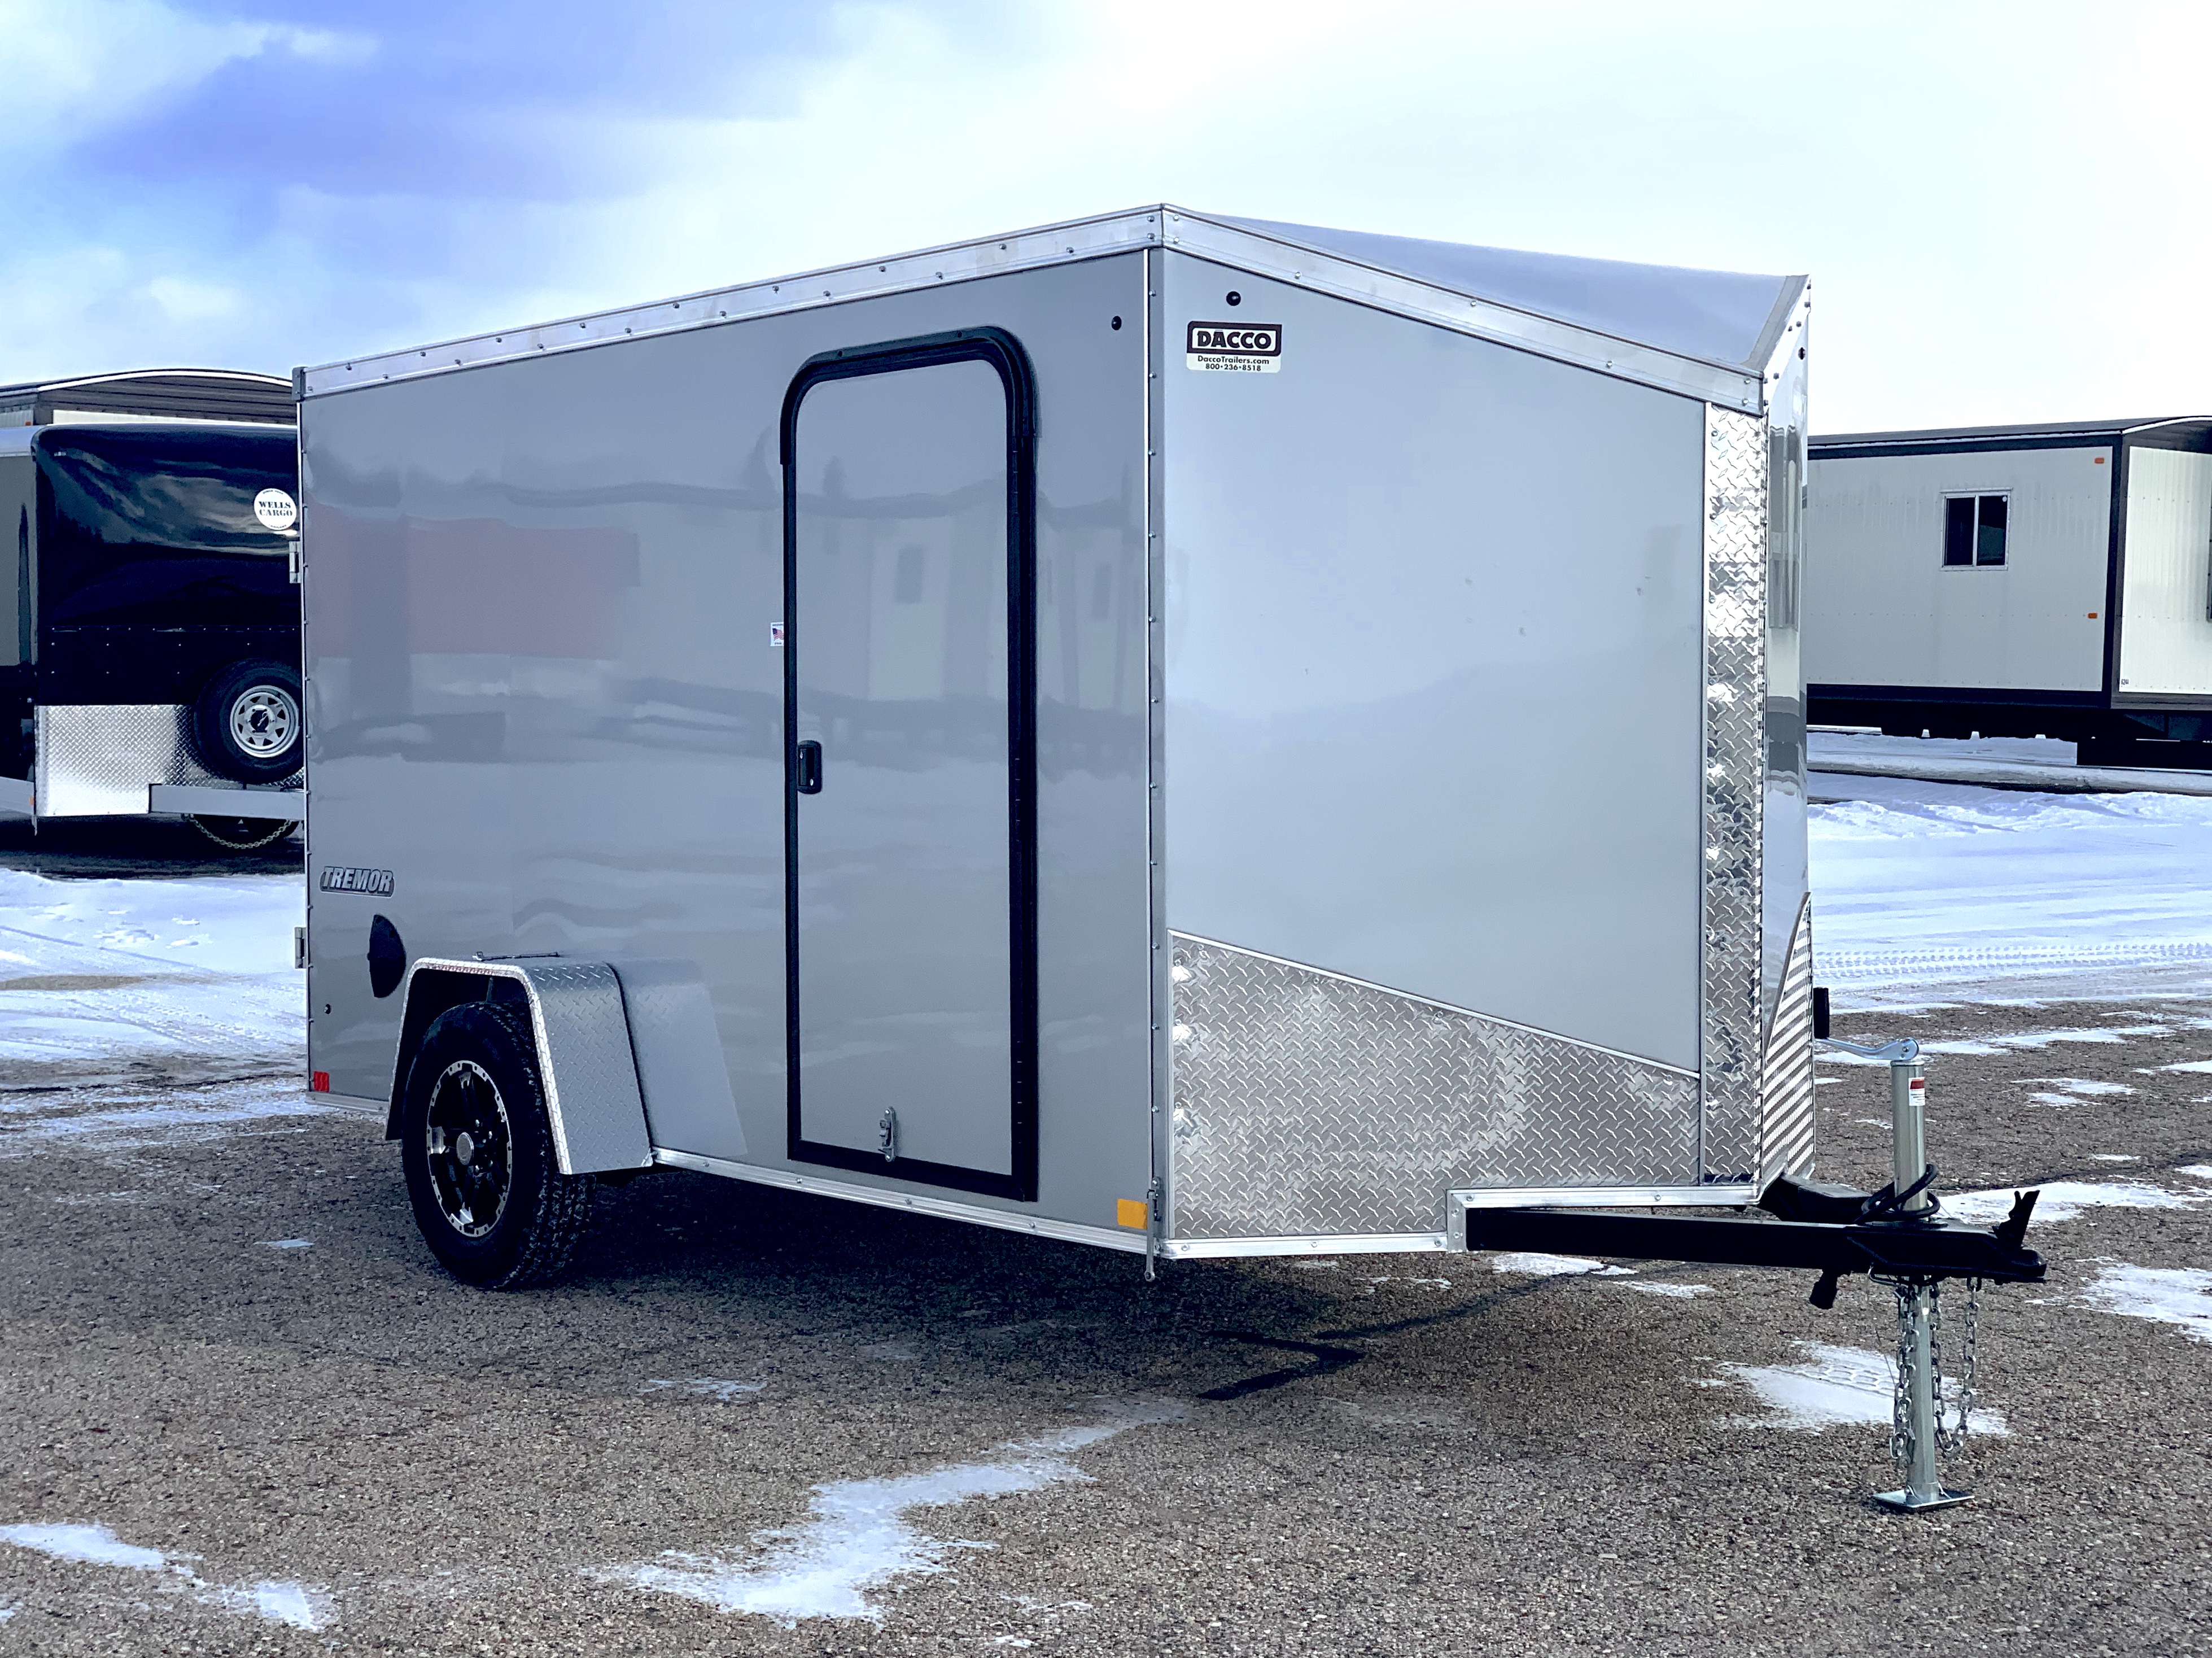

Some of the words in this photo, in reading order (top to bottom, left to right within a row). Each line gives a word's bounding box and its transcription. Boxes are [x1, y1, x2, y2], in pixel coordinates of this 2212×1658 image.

[1197, 330, 1271, 350] DACCO
[1197, 355, 1269, 364] DaccoTrailers.com
[322, 866, 394, 893] TREMOR
